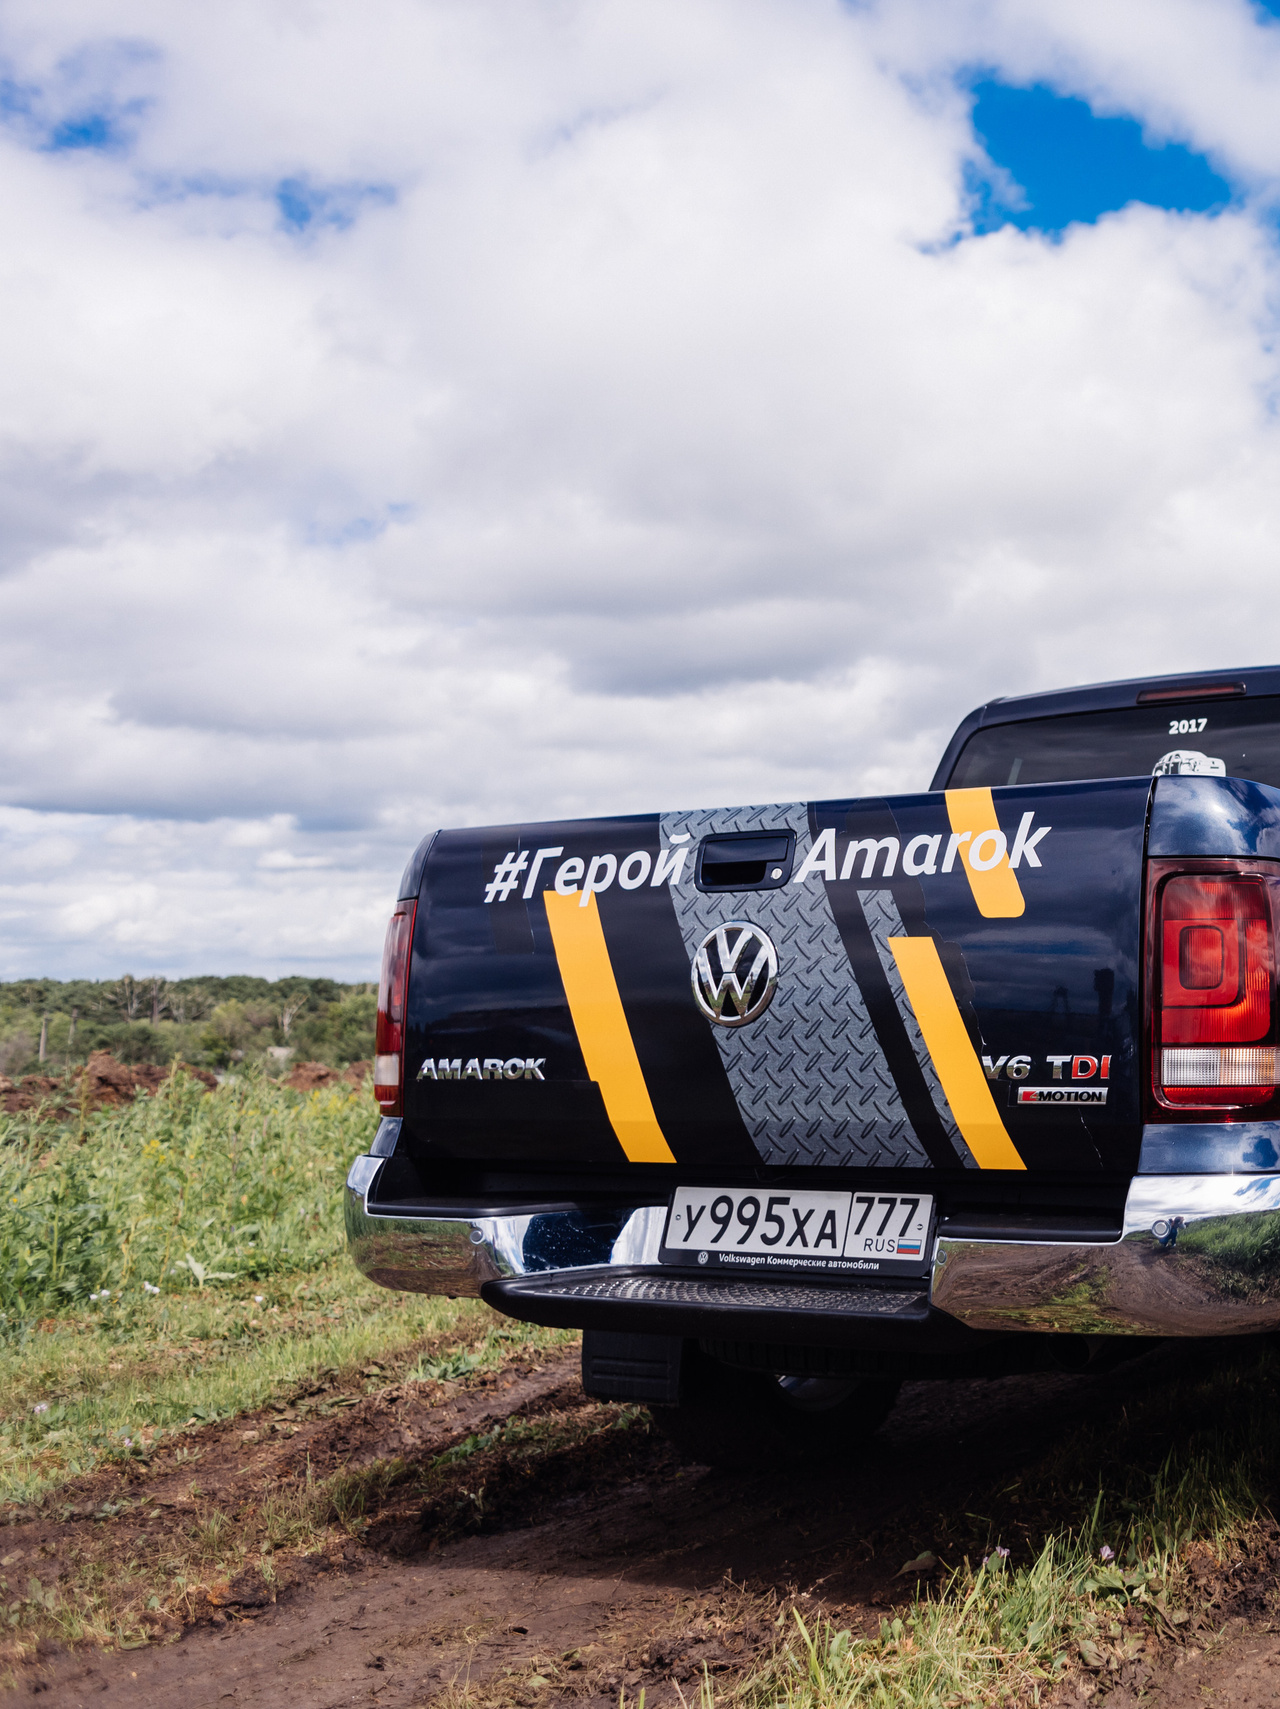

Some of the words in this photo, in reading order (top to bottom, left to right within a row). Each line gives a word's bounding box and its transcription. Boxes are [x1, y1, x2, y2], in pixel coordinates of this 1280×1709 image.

[1168, 718, 1208, 734] 2017
[484, 832, 691, 907] #Герой
[793, 811, 1052, 883] Amarok
[416, 1057, 546, 1080] AMAROK
[981, 1054, 1032, 1080] V6
[1046, 1054, 1112, 1080] TDI
[1024, 1090, 1103, 1102] 4MOTION
[854, 1196, 921, 1237] 777
[863, 1238, 896, 1252] RUS
[718, 1253, 766, 1266] Volkswagen
[767, 1256, 827, 1269] Коммерческие
[827, 1260, 880, 1270] автомобили
